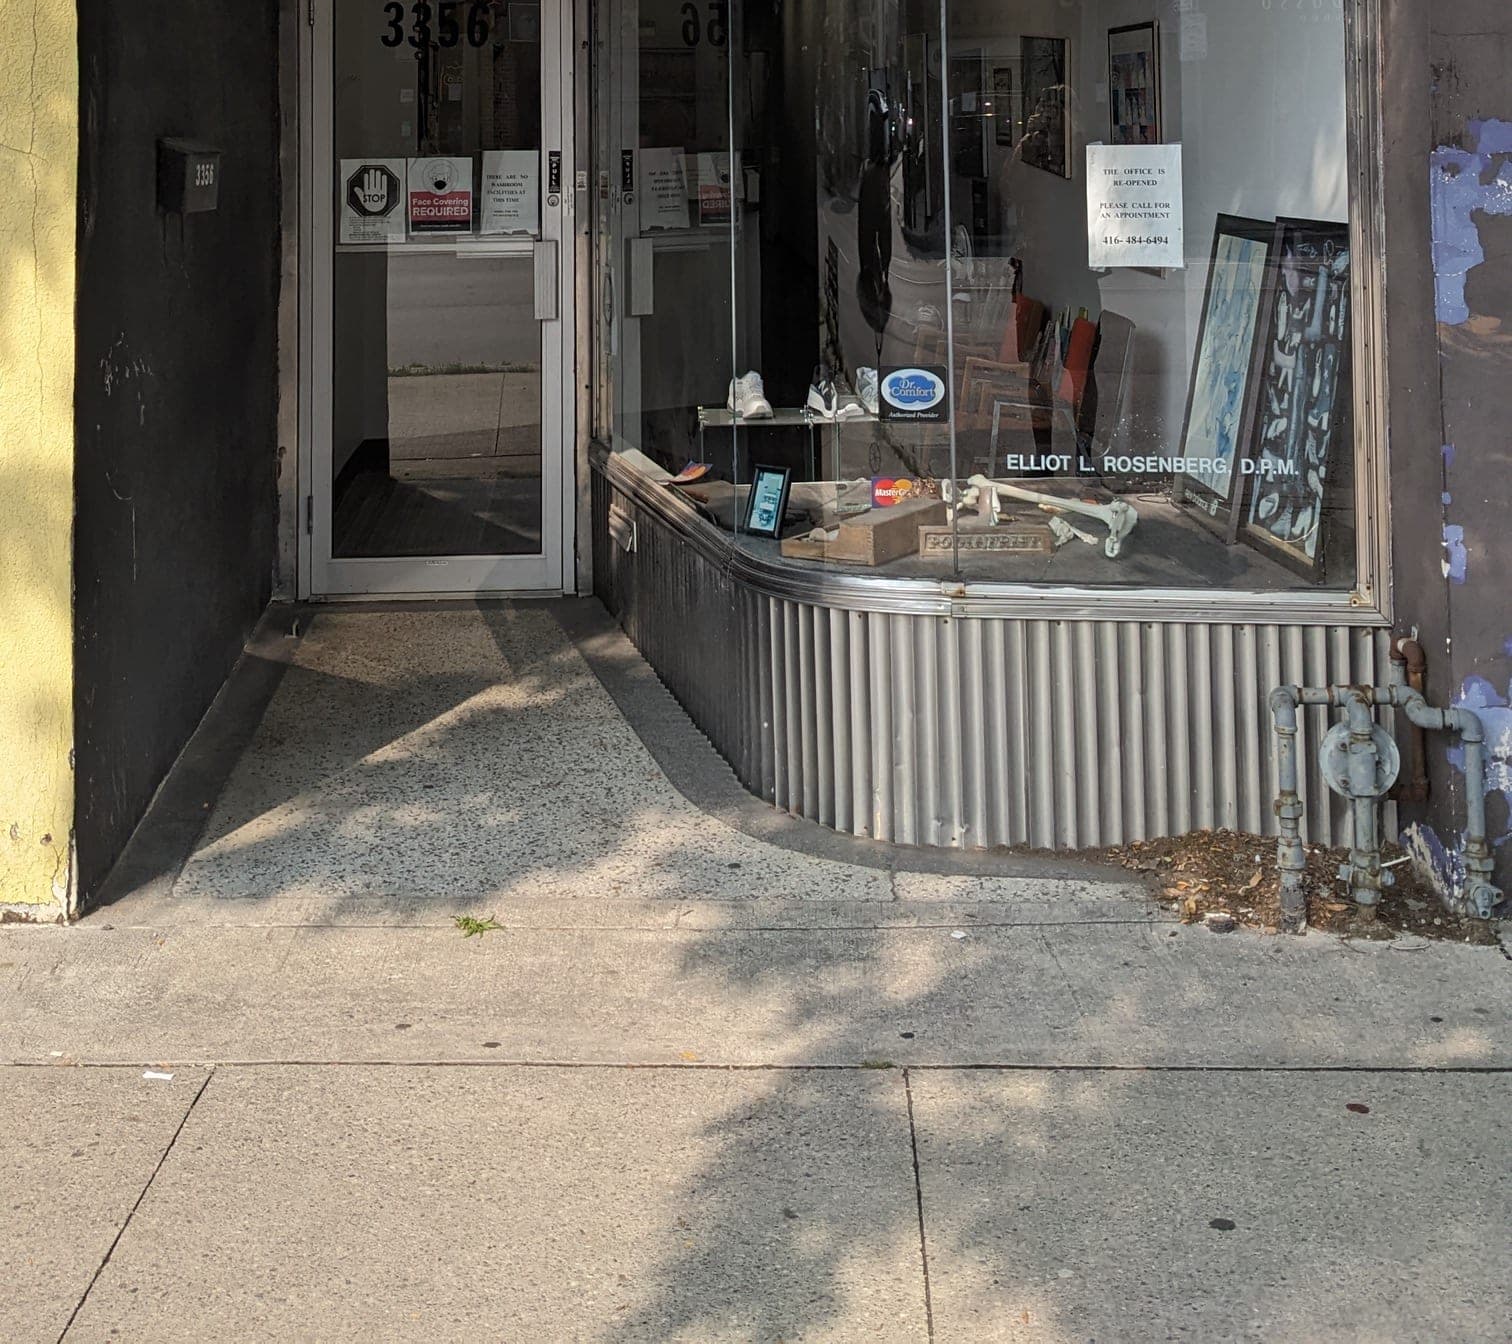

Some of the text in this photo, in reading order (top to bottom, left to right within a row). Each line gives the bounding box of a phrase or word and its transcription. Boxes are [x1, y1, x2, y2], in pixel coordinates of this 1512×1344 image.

[380, 0, 491, 48] 3356
[362, 194, 386, 203] STOP
[433, 197, 469, 206] Covering
[412, 207, 469, 217] REQUIRED
[1126, 236, 1169, 245] 484-6494
[899, 379, 916, 389] Dr.
[891, 386, 934, 397] Comfort
[1006, 453, 1072, 472] ELLIOT
[1079, 455, 1095, 472] L.
[1240, 458, 1299, 476] D.P.M.
[874, 487, 911, 496] MasterC
